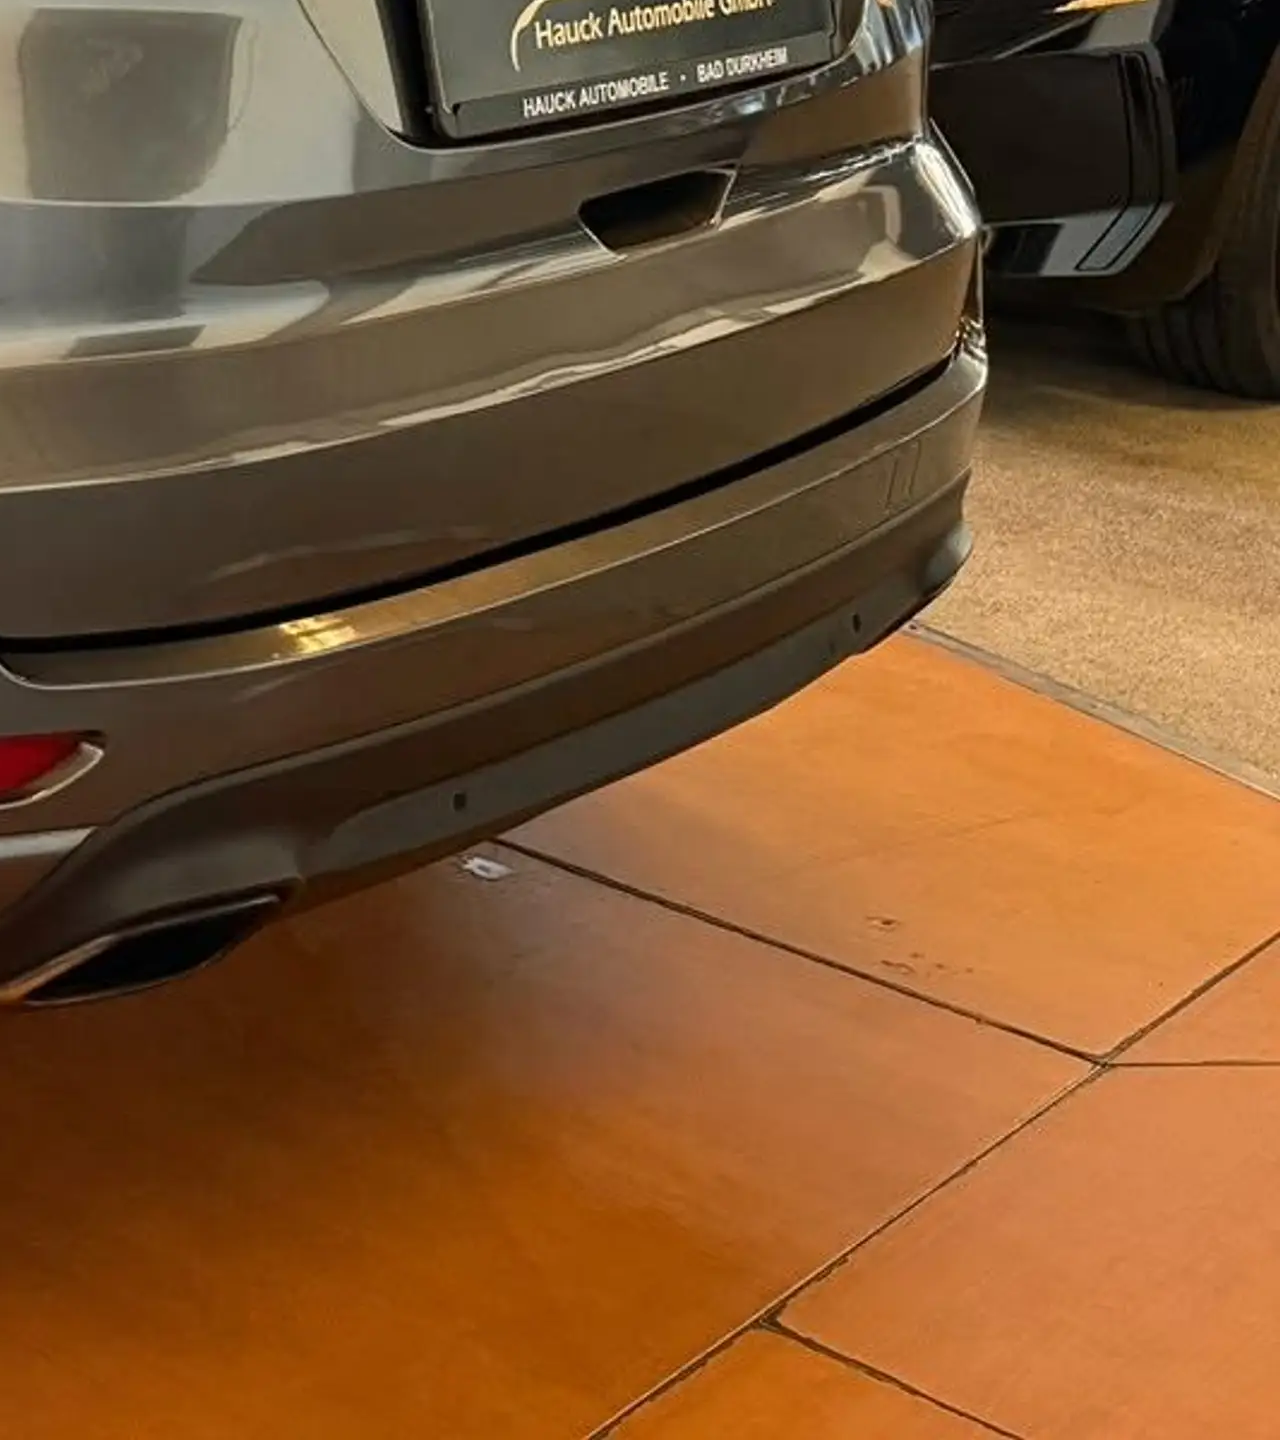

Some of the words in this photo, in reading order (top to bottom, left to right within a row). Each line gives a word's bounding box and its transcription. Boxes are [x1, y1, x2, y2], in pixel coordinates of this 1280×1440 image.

[534, 10, 606, 50] Hauck
[523, 90, 576, 119] HAUCK
[578, 71, 670, 106] AUTOMOBILE
[696, 61, 725, 84] BAD
